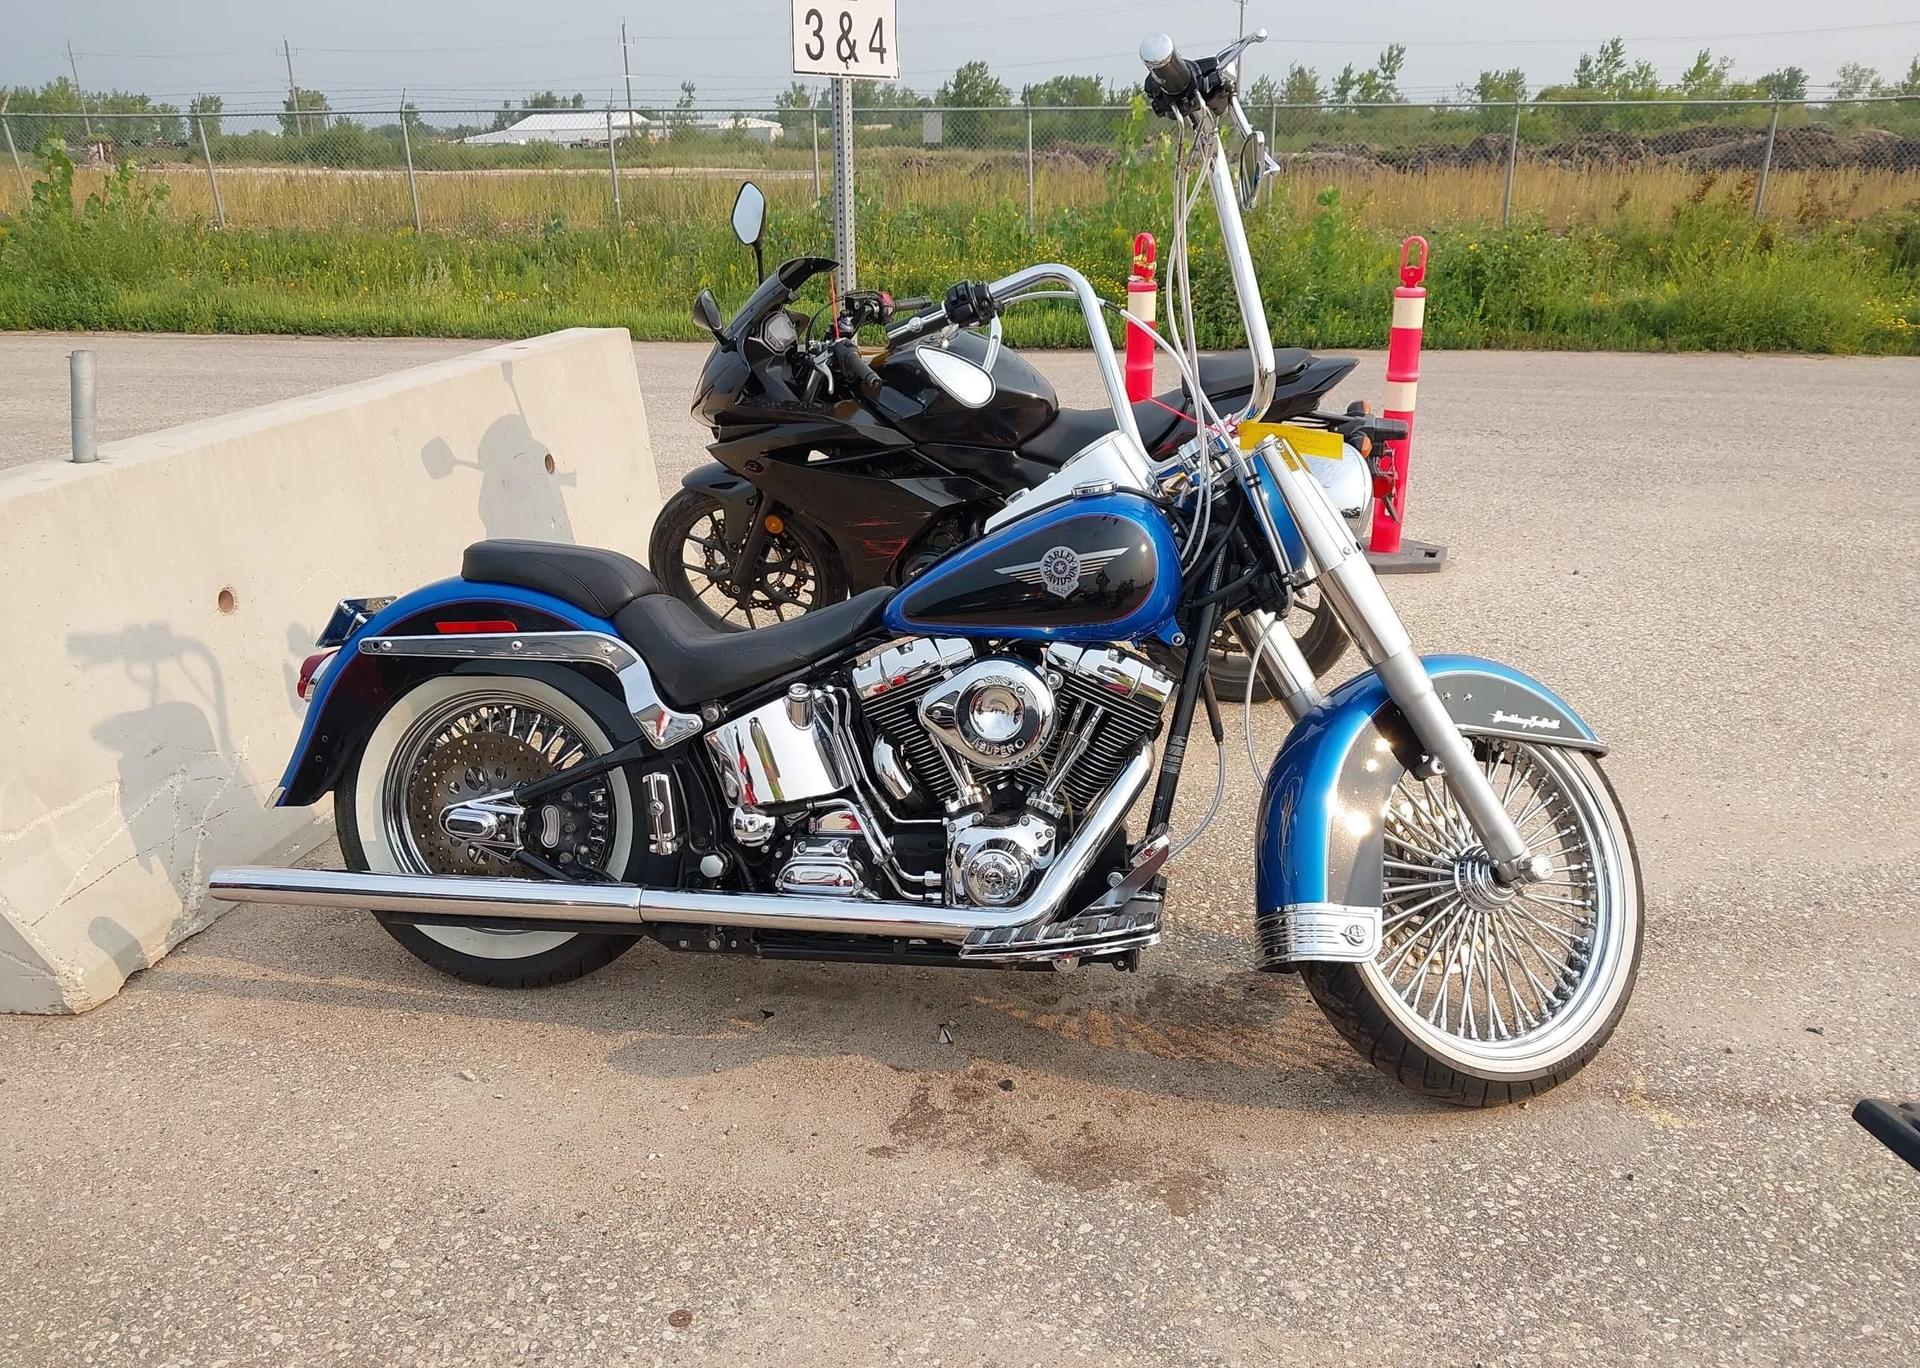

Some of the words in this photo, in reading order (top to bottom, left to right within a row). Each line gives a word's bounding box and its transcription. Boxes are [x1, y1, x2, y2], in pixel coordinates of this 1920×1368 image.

[805, 8, 825, 61] 3
[836, 11, 860, 64] &
[868, 17, 887, 64] 4
[1043, 550, 1077, 567] HARLEY
[1044, 566, 1077, 585] DAVIDSON
[978, 740, 1016, 756] SUPER
